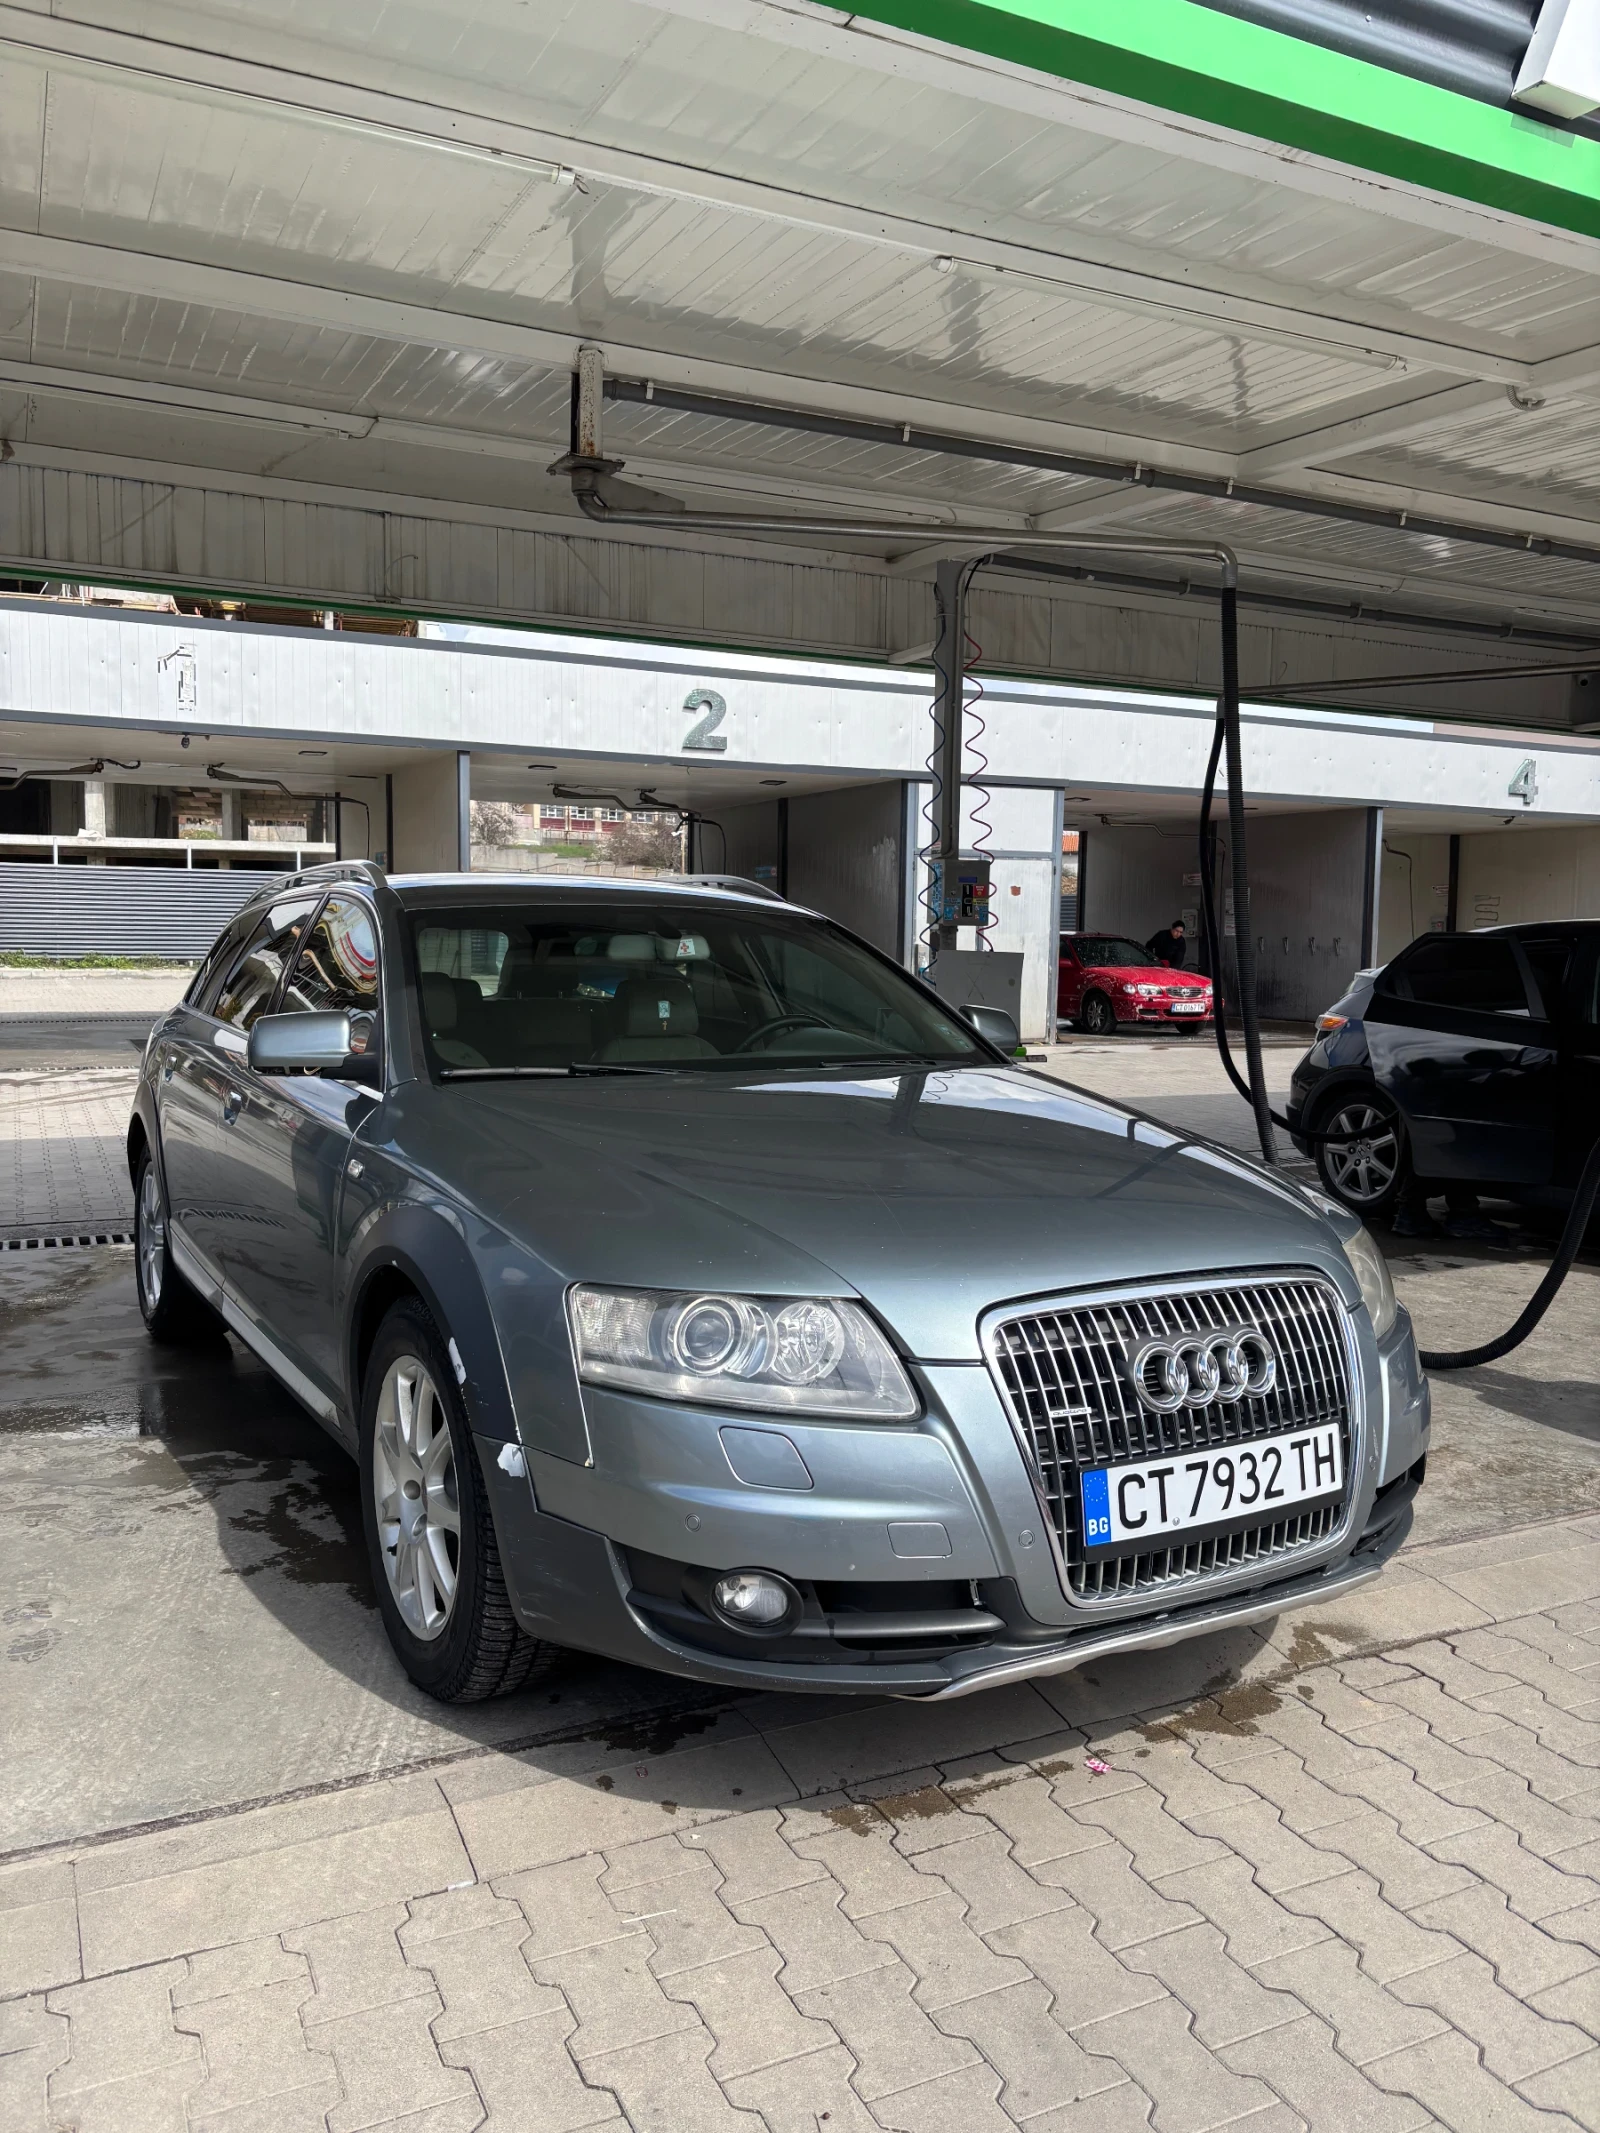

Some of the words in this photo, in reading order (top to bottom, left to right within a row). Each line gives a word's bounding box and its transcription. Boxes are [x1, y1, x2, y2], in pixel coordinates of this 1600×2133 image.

[682, 688, 728, 752] 2
[1508, 758, 1539, 804] 4
[1052, 1408, 1087, 1417] quattro
[1117, 1466, 1174, 1530] CT
[1185, 1446, 1285, 1518] 7932
[1290, 1432, 1336, 1491] TH
[1088, 1518, 1108, 1536] BG
